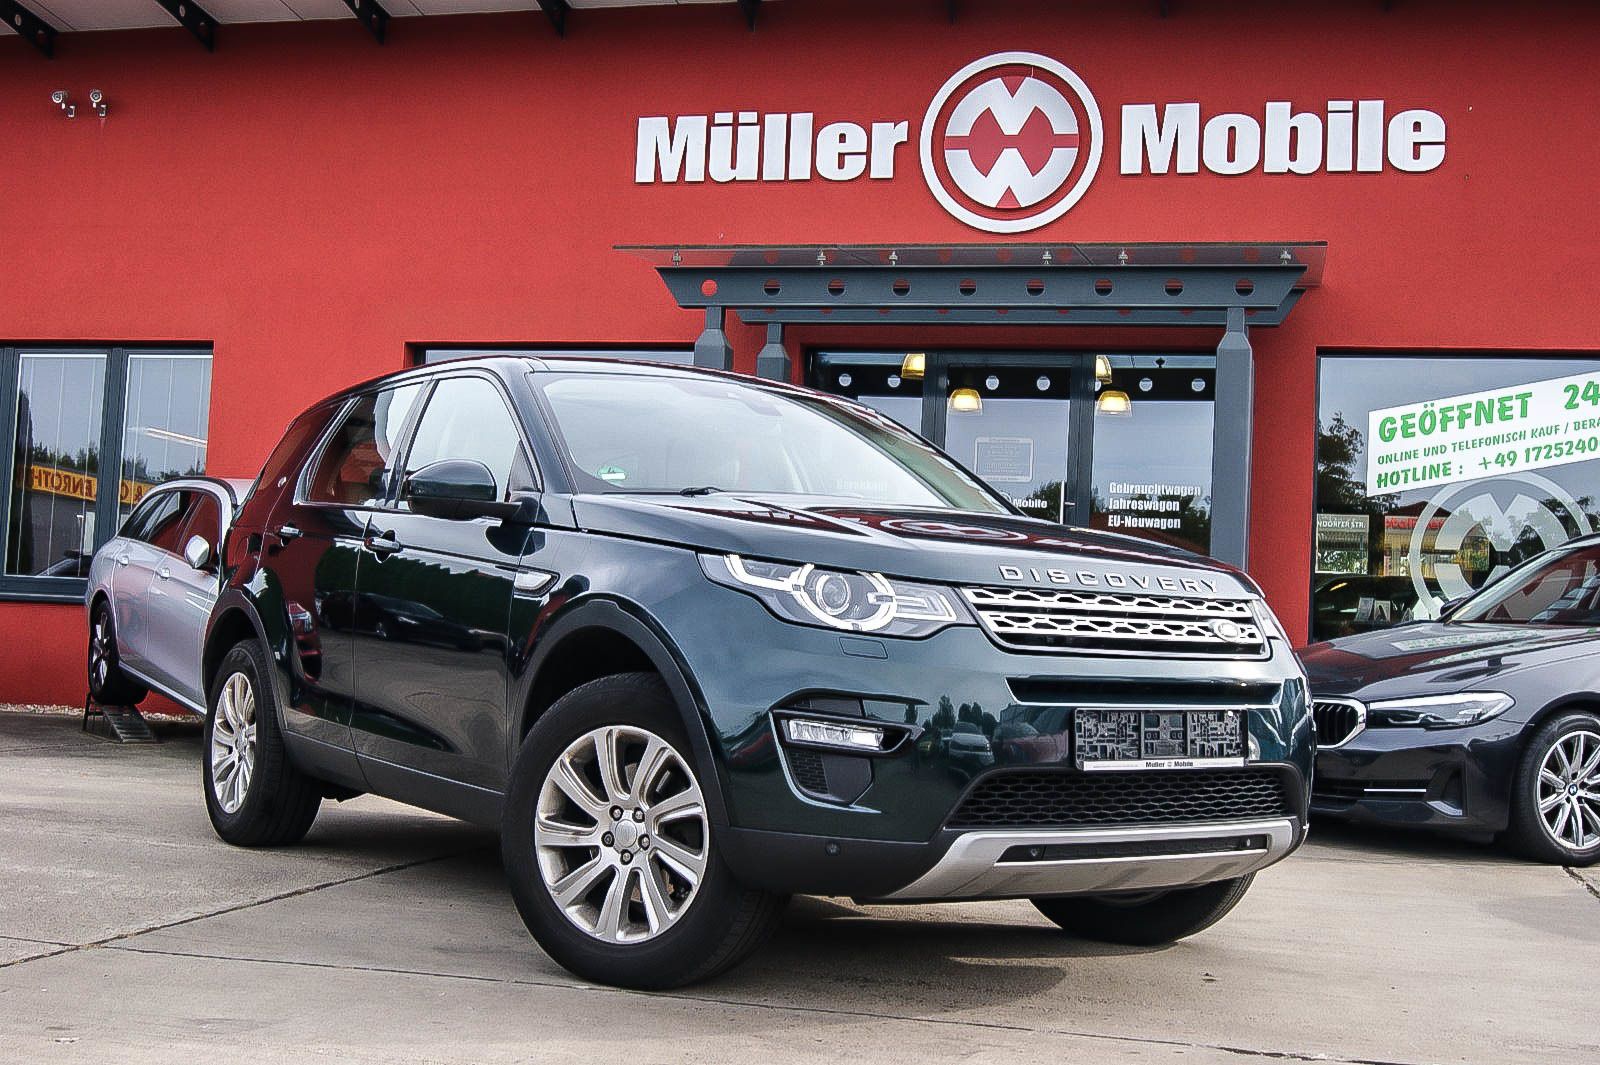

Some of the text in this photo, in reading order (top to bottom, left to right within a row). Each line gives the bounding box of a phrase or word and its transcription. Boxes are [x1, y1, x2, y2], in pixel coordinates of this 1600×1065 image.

[634, 100, 1447, 184] Müller Mobile
[1378, 380, 1600, 443] GEÖFFNET 24
[1377, 449, 1419, 465] ONLINE
[1423, 444, 1447, 457] UND
[1451, 430, 1527, 453] TELEFONISCH
[1530, 424, 1561, 439] KAUF
[1377, 461, 1451, 488] HOTLINE
[1478, 450, 1518, 470] +49
[1525, 436, 1600, 463] 1725240
[1108, 498, 1180, 512] Jahreswagen
[1109, 482, 1201, 497] Gebrauchtwagen
[1108, 514, 1181, 530] EU-Neuwagen
[999, 565, 1217, 592] DISCOVERY
